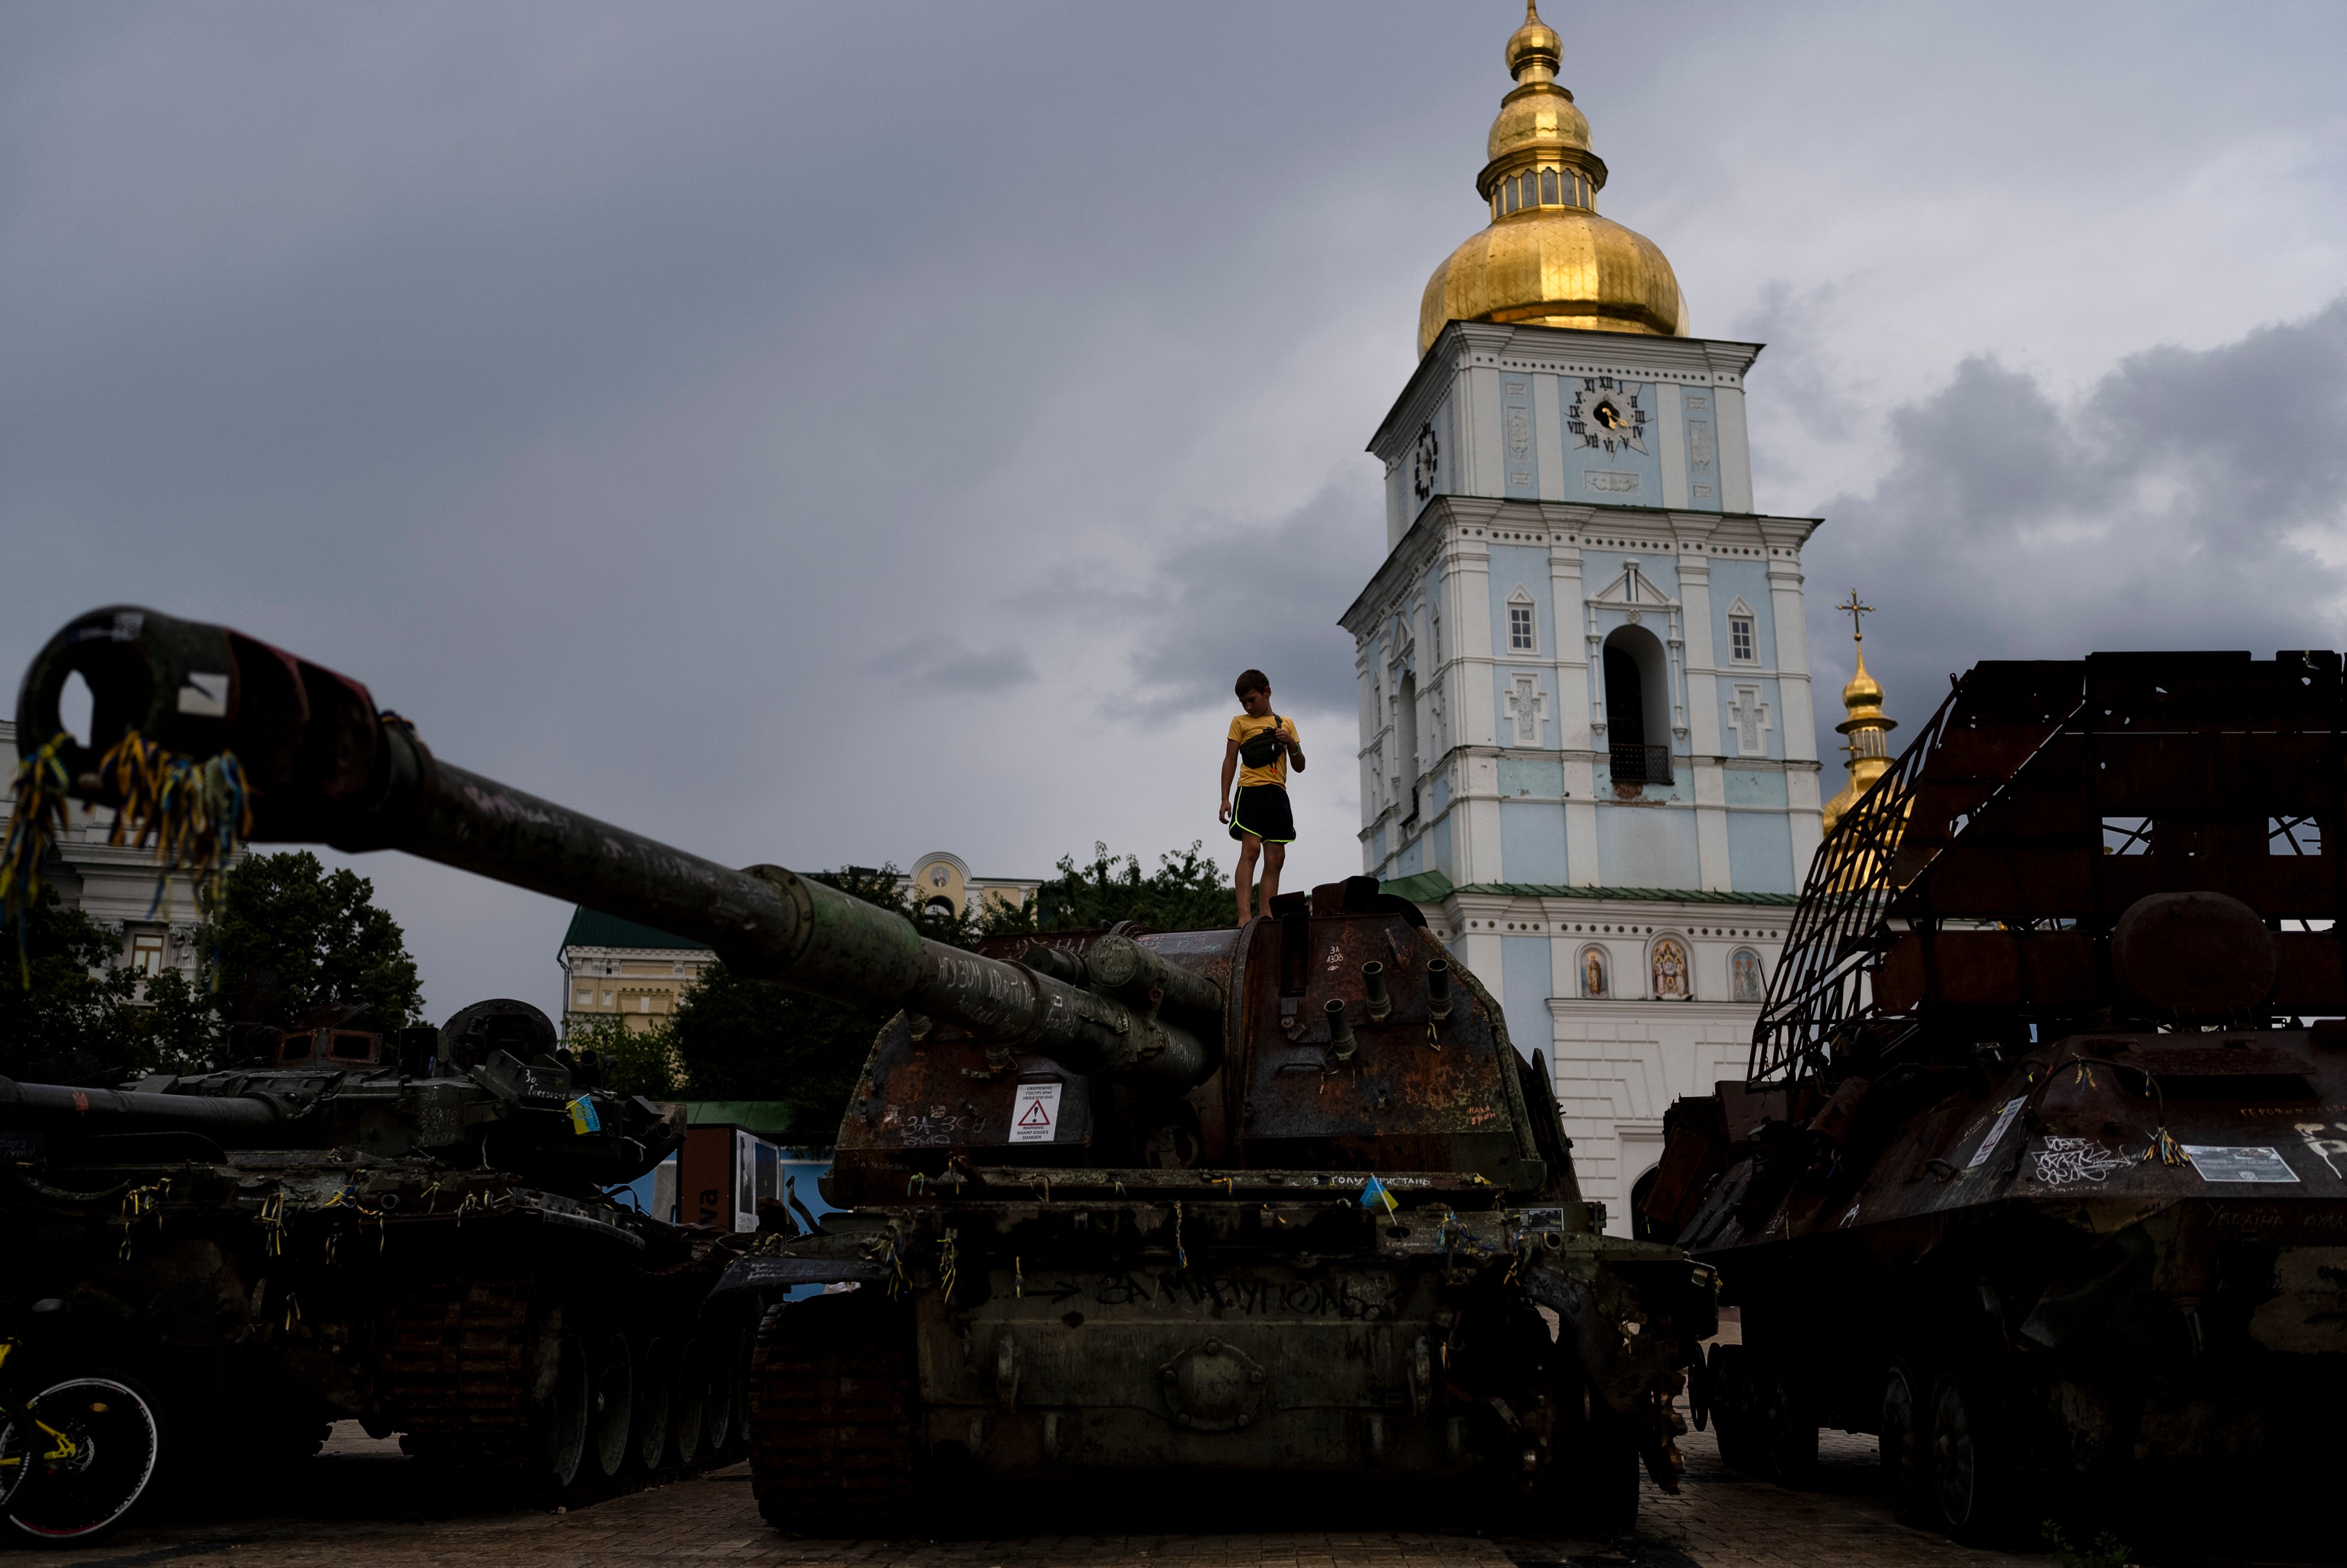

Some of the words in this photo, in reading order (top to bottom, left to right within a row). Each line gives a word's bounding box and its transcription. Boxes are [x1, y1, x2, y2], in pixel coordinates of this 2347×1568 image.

[1584, 379, 1595, 394] XI
[1599, 376, 1613, 389] XII
[1619, 381, 1623, 394] I
[1575, 391, 1583, 404] X
[1631, 396, 1637, 408] II
[1570, 405, 1580, 417] IX
[1634, 410, 1645, 423] III
[1567, 421, 1585, 434] VIII
[1632, 426, 1643, 438] IV
[1584, 434, 1599, 448] VII
[1603, 440, 1614, 453] VI
[1623, 438, 1629, 450] V
[1096, 1268, 1152, 1305] ЗА
